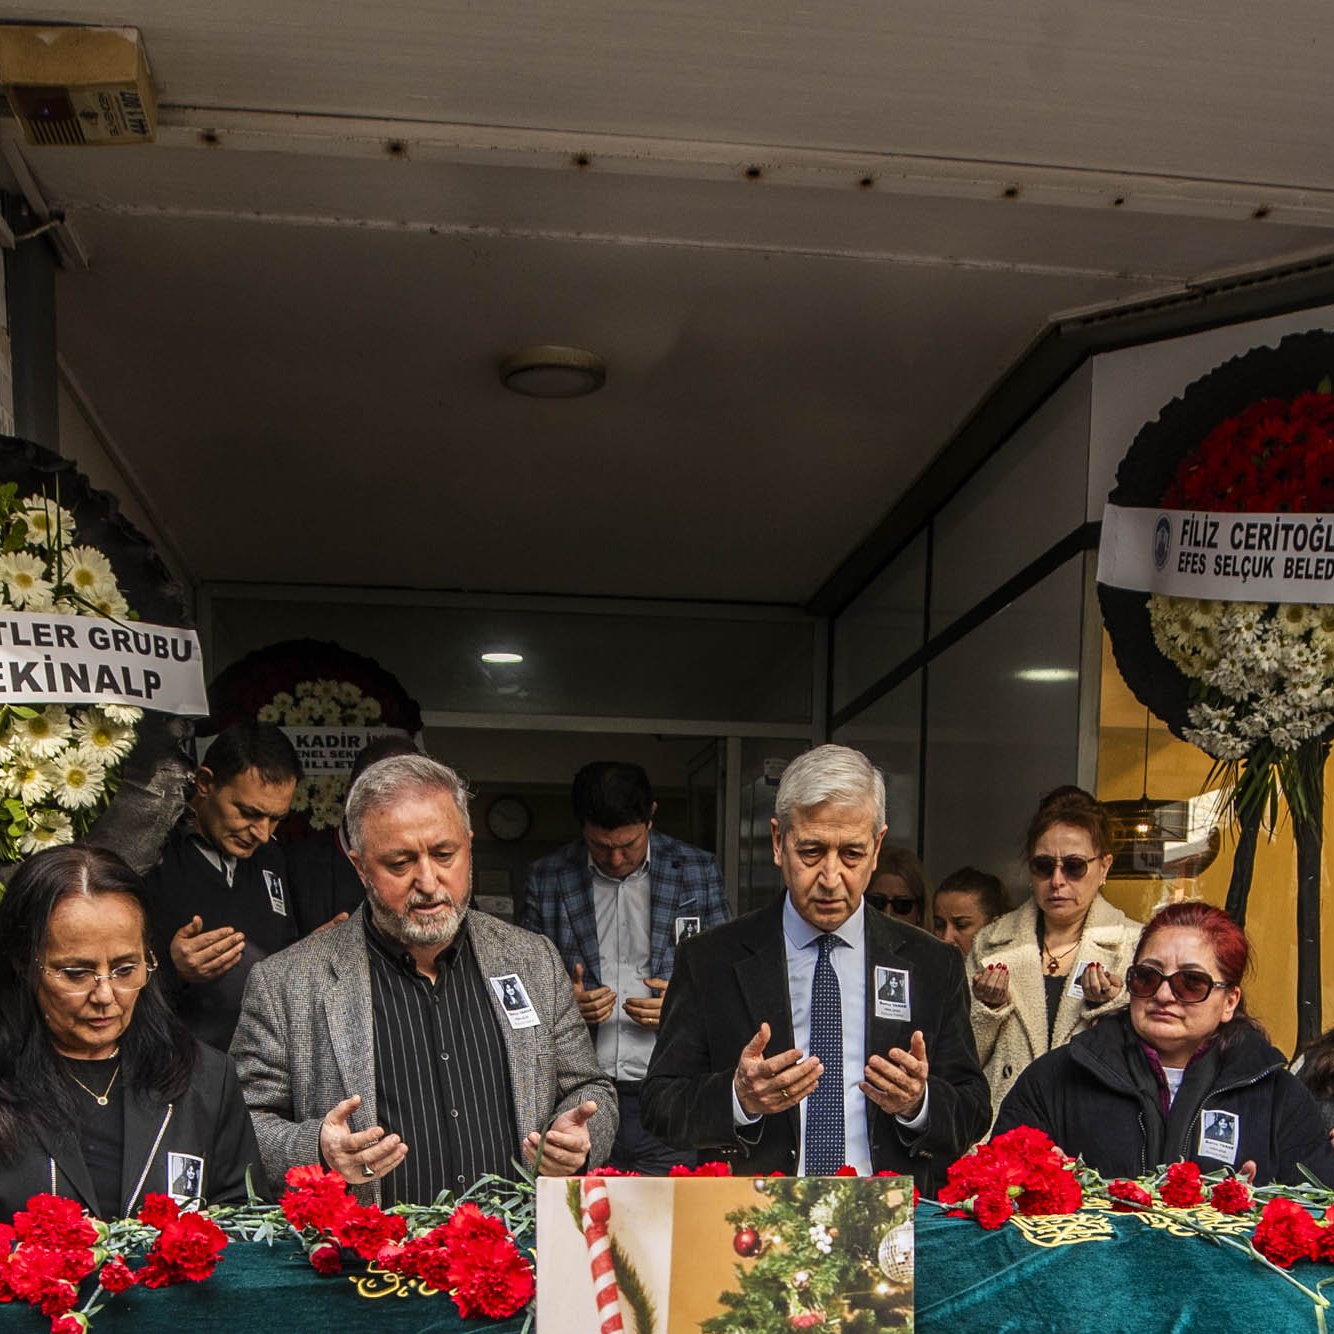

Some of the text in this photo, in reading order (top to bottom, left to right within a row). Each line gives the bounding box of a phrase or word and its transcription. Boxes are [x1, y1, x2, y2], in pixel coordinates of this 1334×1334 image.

[1180, 513, 1219, 548] FİLİZ
[1177, 551, 1206, 575] EFES
[1214, 554, 1274, 583] SELÇUK
[88, 626, 192, 663] GRUBU
[296, 732, 361, 748] KADİR
